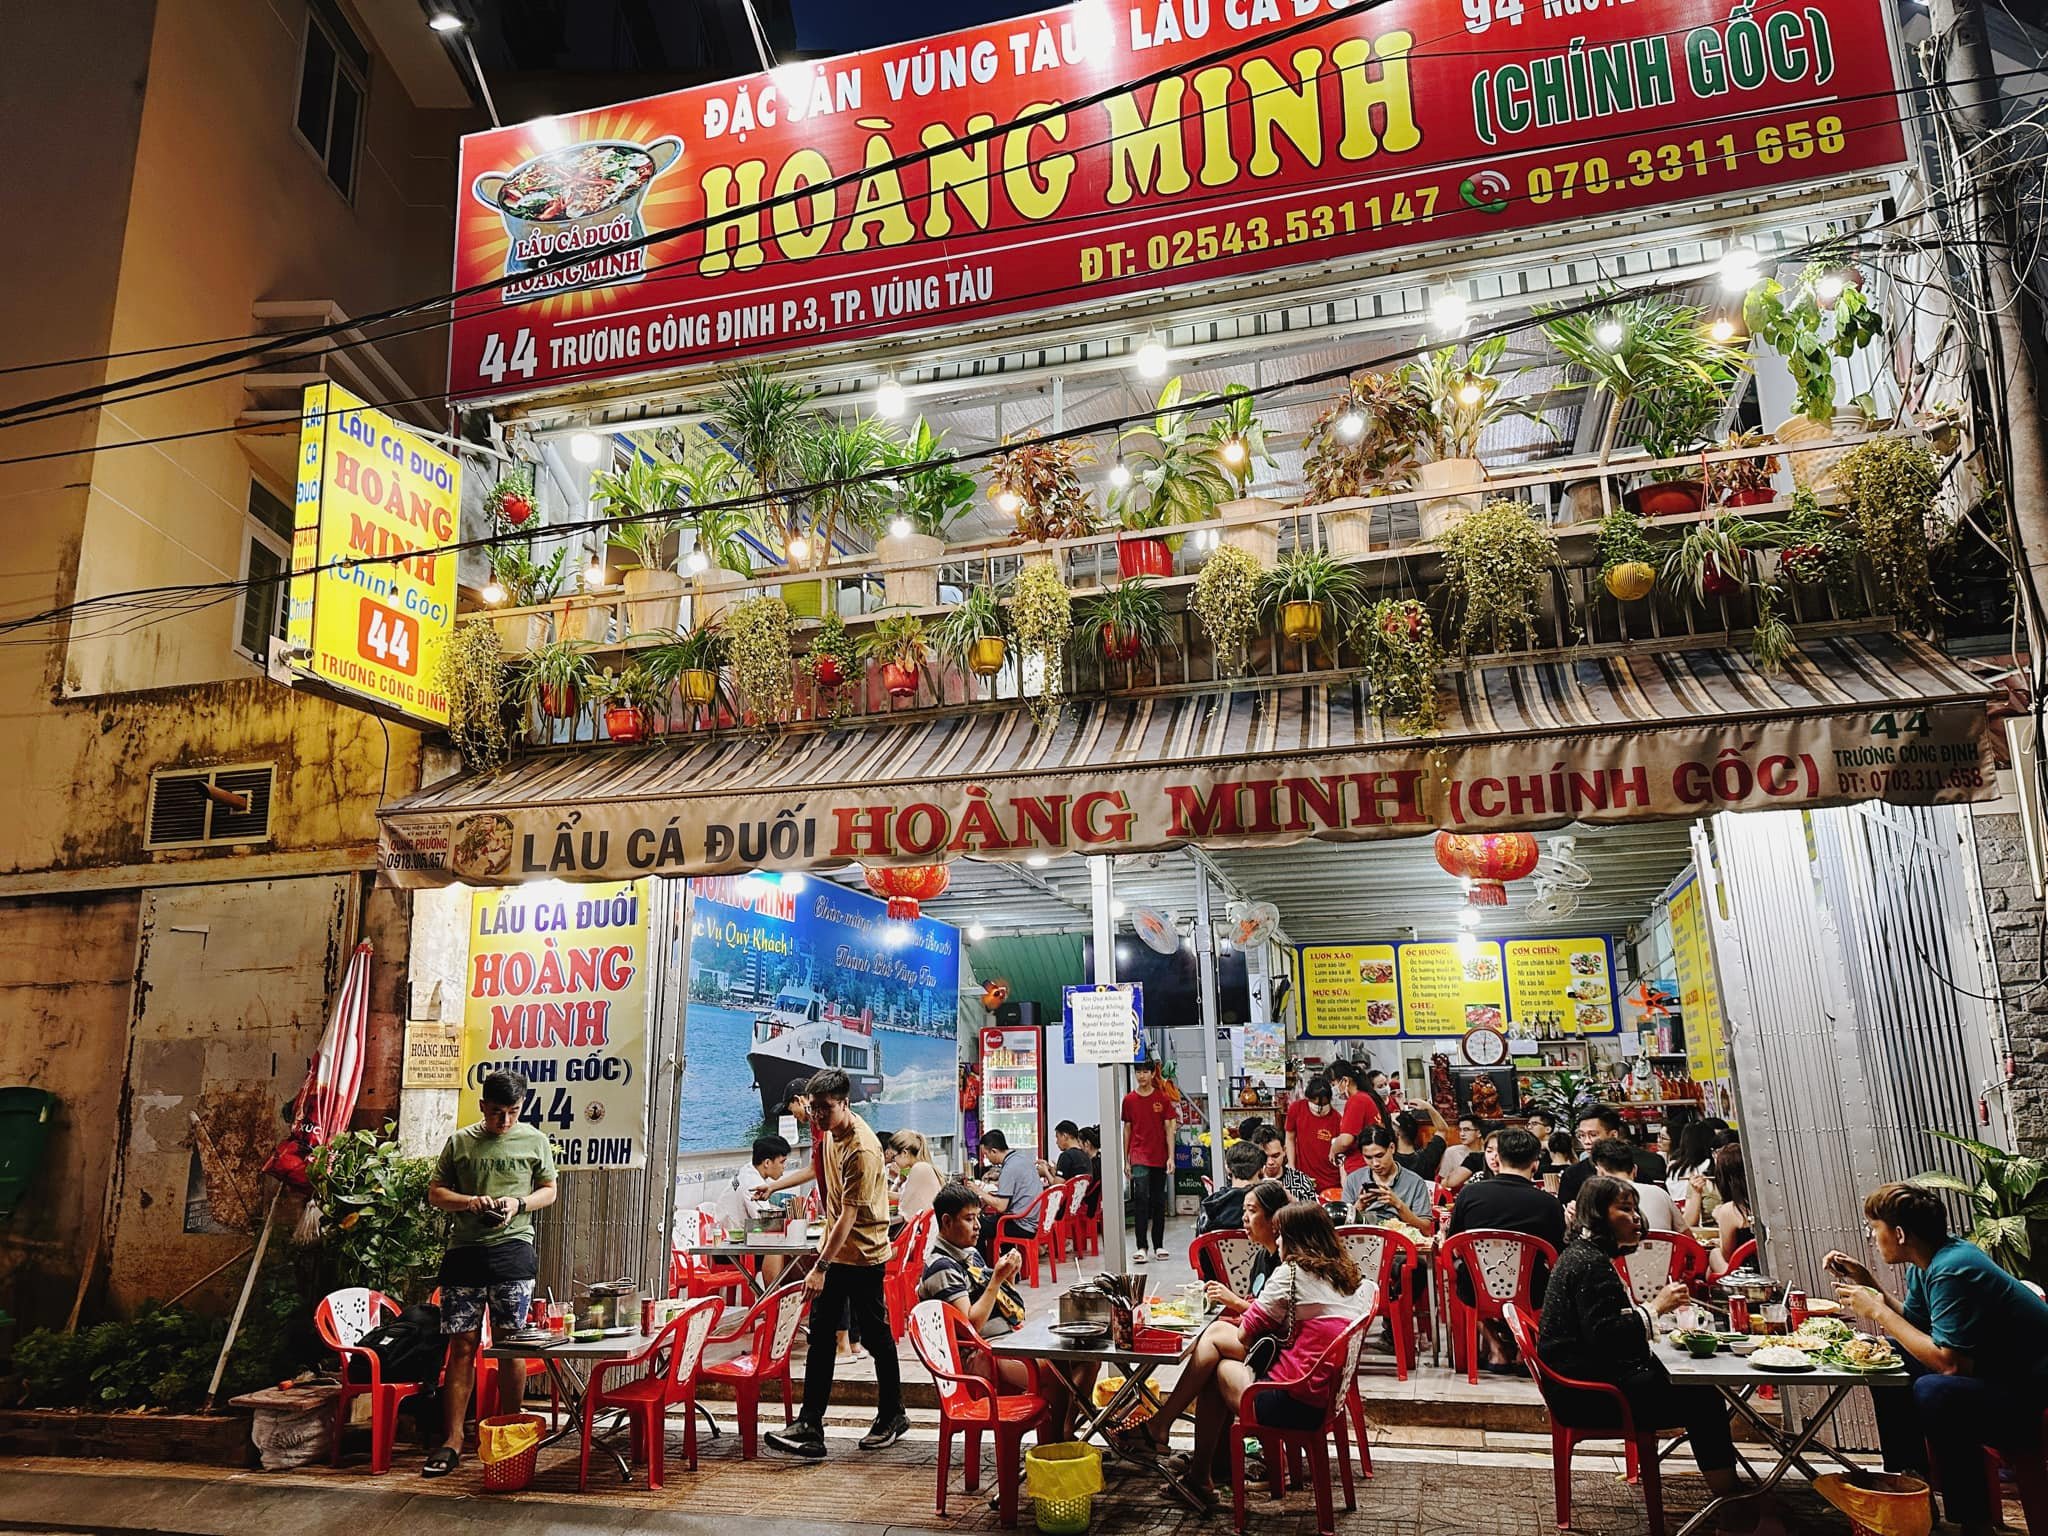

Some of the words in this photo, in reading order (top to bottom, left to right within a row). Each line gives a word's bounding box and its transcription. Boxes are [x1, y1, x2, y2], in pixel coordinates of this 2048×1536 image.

[704, 84, 776, 143] ĐẶC
[882, 44, 998, 101] VŨNG
[1009, 21, 1085, 76] TÀU
[1472, 37, 1676, 145] (CHÍNH
[1684, 0, 1836, 99] GỐC)
[698, 100, 1076, 277] HOÀNG
[1103, 29, 1421, 205] MINH
[1079, 245, 1137, 284] ĐT:
[1146, 184, 1441, 273] 02543.531147
[1526, 134, 1739, 205] 070.3311
[1756, 115, 1847, 165] 658
[517, 229, 552, 260] LẨU
[557, 227, 582, 251] CÁ
[585, 214, 631, 246] ĐUỐI
[583, 250, 641, 281] MINH
[478, 327, 539, 384] 44
[549, 325, 641, 370] TRƯƠNG
[646, 313, 711, 355] CÔNG
[716, 309, 775, 348] ĐỊNH
[782, 299, 827, 334] P.3,
[830, 290, 866, 328] TP.
[872, 276, 941, 317] VŨNG
[945, 264, 995, 305] TÀU
[297, 472, 320, 503] ĐUỐ
[381, 437, 404, 465] CÁ
[410, 451, 454, 494] ĐUỐI
[335, 450, 453, 542] HOÀNG
[349, 513, 437, 586] MINH
[405, 587, 449, 628] Gốc)
[367, 608, 411, 669] 44
[321, 652, 376, 689] TRƯƠNG
[380, 669, 414, 702] CÔNG
[417, 686, 448, 715] ĐỊNH
[1871, 711, 1933, 739] 44
[1832, 746, 1896, 768] TRƯƠNG
[1899, 741, 1936, 763] CÔNG
[1941, 743, 1980, 766] ĐỊNH
[1838, 772, 1866, 794] ĐT:
[1870, 768, 1984, 793] 0703.311.658
[521, 811, 609, 873] LẨU
[627, 816, 685, 869] CÁ
[704, 803, 816, 864] ĐUỐI
[829, 785, 1138, 857] HOÀNG
[1164, 768, 1433, 838] MINH
[1449, 761, 1651, 825] (CHÍNH
[1673, 741, 1820, 802] GỐC)
[576, 887, 639, 929] ĐUỐI
[707, 917, 722, 948] Vụ
[726, 921, 750, 954] Quý
[753, 927, 787, 957] Khách
[471, 937, 635, 998] HOÀNG
[488, 999, 611, 1050] MINH
[411, 1041, 438, 1057] HOÀNG
[440, 1044, 460, 1057] MINH
[565, 1049, 633, 1086] GỐC)
[518, 1087, 575, 1131] 44
[587, 1138, 633, 1171] ĐỊNH
